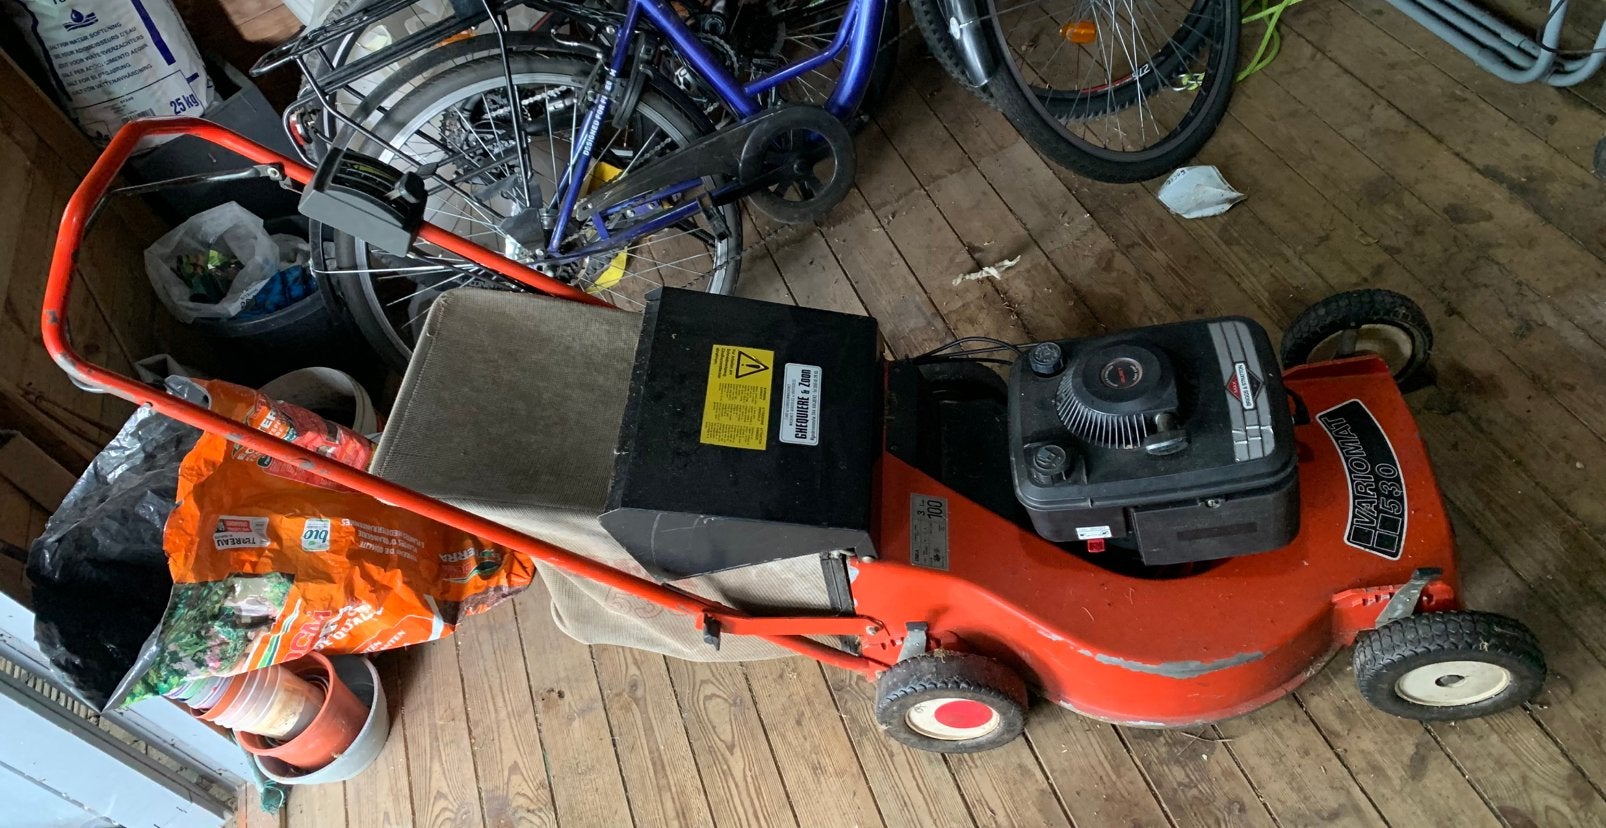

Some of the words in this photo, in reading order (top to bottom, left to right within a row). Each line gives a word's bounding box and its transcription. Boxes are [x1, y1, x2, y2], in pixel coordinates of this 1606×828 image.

[68, 35, 88, 45] WATER
[88, 21, 121, 38] SOFTENING
[170, 98, 186, 115] 25
[183, 93, 199, 108] kg
[583, 121, 600, 156] DESIGNED
[595, 102, 606, 120] FOR
[798, 369, 811, 387] Zoon
[794, 396, 810, 439] GHEQUIERE
[1321, 416, 1377, 526] VARIOMAT
[1376, 463, 1402, 514] 530
[927, 500, 942, 518] 100
[217, 538, 256, 546] TERREAU
[304, 530, 328, 543] bio
